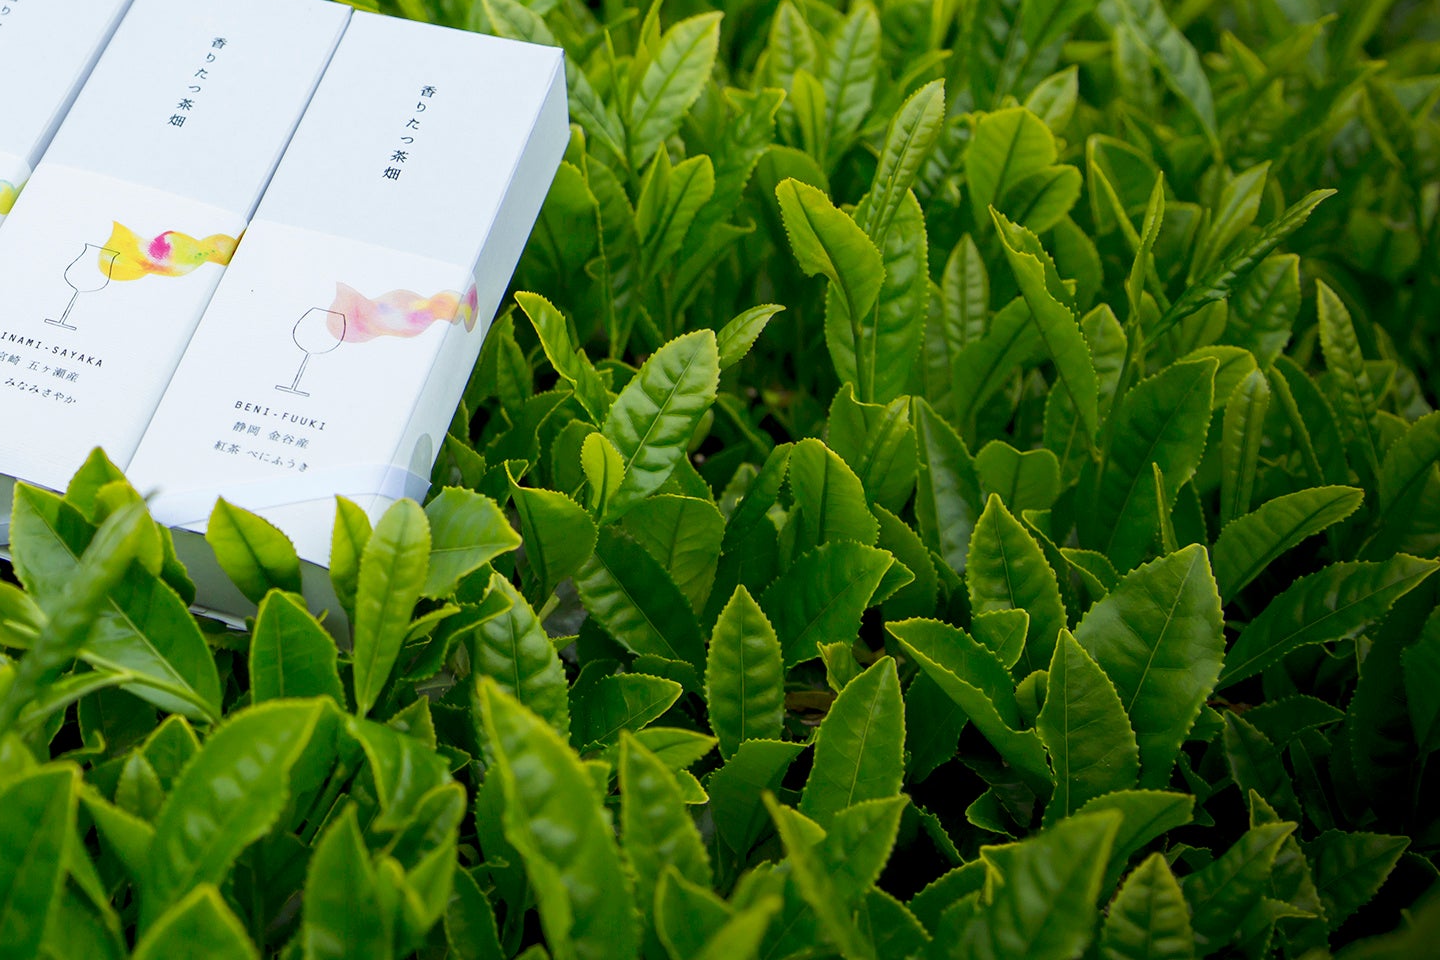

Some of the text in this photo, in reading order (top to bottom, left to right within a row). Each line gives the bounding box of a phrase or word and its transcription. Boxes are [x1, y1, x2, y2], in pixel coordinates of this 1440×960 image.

[167, 37, 227, 127] 香りたつ茶畑
[382, 85, 437, 180] 香りたつ茶畑
[5, 378, 77, 404] みなみさやか
[234, 400, 326, 431] BENI-FUUKI
[214, 440, 241, 455] 紅茶
[233, 421, 310, 449] 静岡 金谷産
